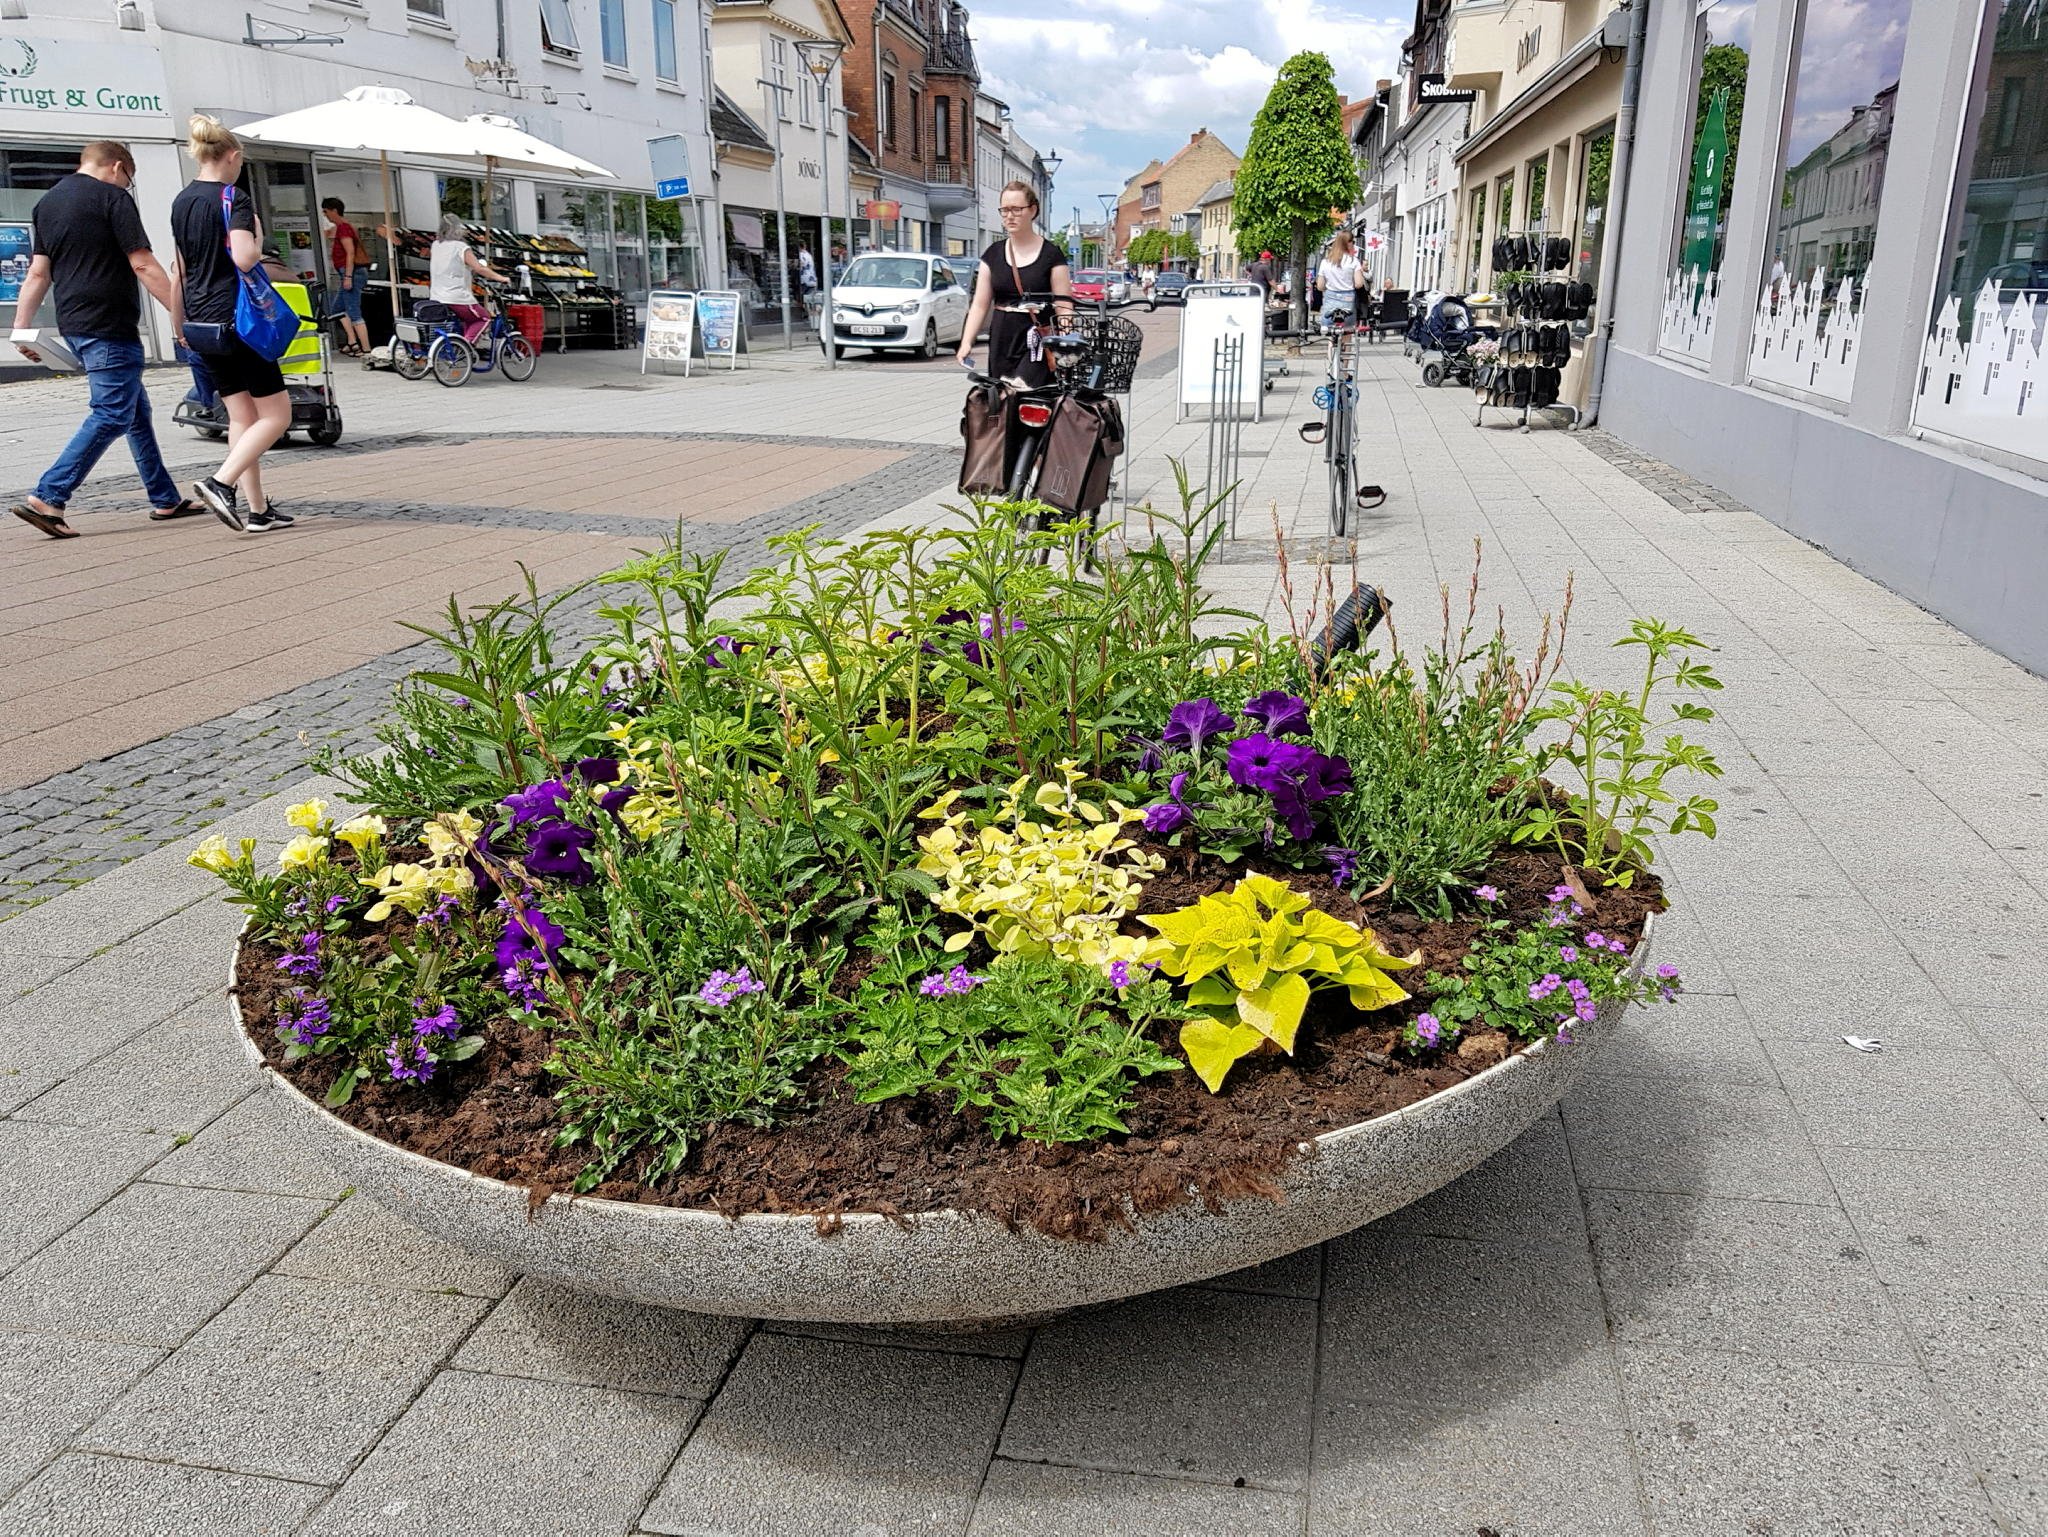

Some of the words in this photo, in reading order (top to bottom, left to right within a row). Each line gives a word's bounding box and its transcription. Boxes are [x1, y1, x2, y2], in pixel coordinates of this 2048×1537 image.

[0, 81, 58, 109] Frugt
[66, 89, 88, 107] &
[96, 87, 163, 111] Grønt
